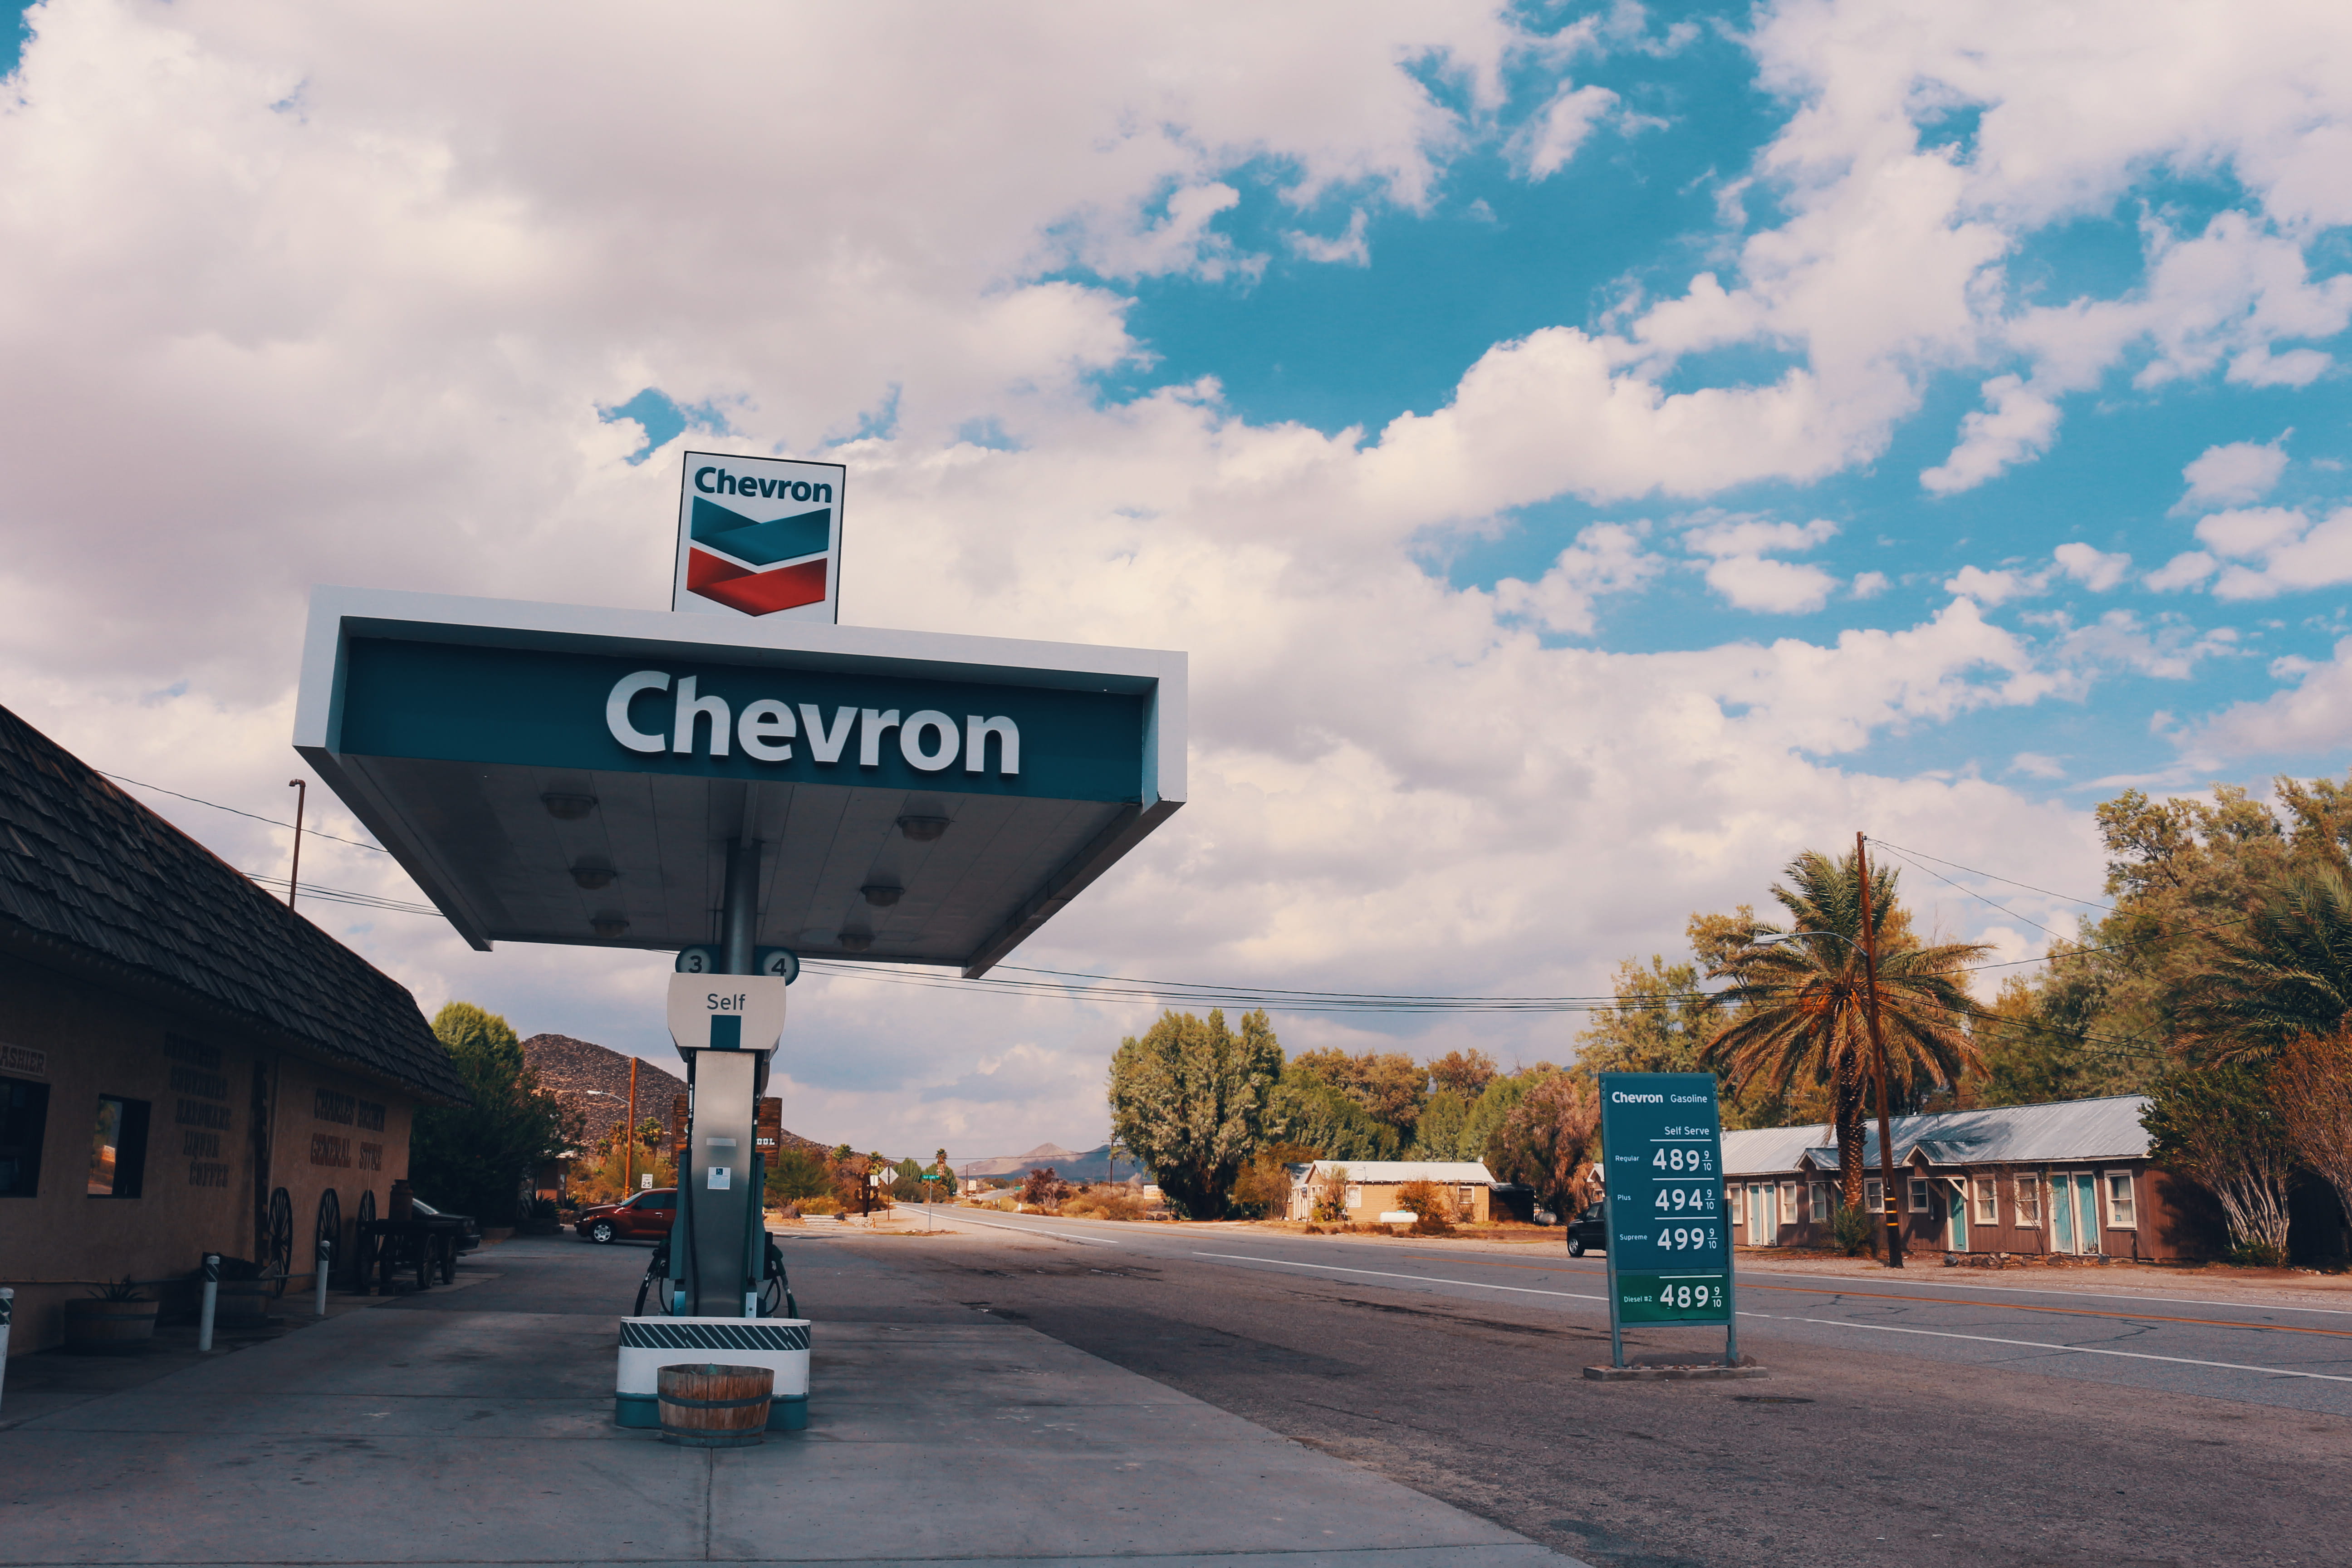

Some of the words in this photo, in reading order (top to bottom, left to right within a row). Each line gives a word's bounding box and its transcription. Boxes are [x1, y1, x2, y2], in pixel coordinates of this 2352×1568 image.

[694, 466, 833, 503] Chevron
[606, 671, 1019, 774] Chevron
[688, 955, 702, 974] 3
[771, 958, 787, 976] 4
[707, 993, 746, 1011] Self
[0, 1045, 44, 1073] ASHIER
[314, 1088, 356, 1125] CHARLES
[1612, 1091, 1663, 1103] Chevron
[1670, 1094, 1708, 1103] Gasoline
[1664, 1126, 1681, 1136] Self
[1684, 1126, 1710, 1136] Serve
[310, 1132, 352, 1168] GENERAL
[1652, 1148, 1700, 1171] 489
[189, 1161, 228, 1187] COFFEE
[1655, 1189, 1703, 1211] 494
[1657, 1228, 1705, 1250] 499
[1660, 1284, 1709, 1308] 489
